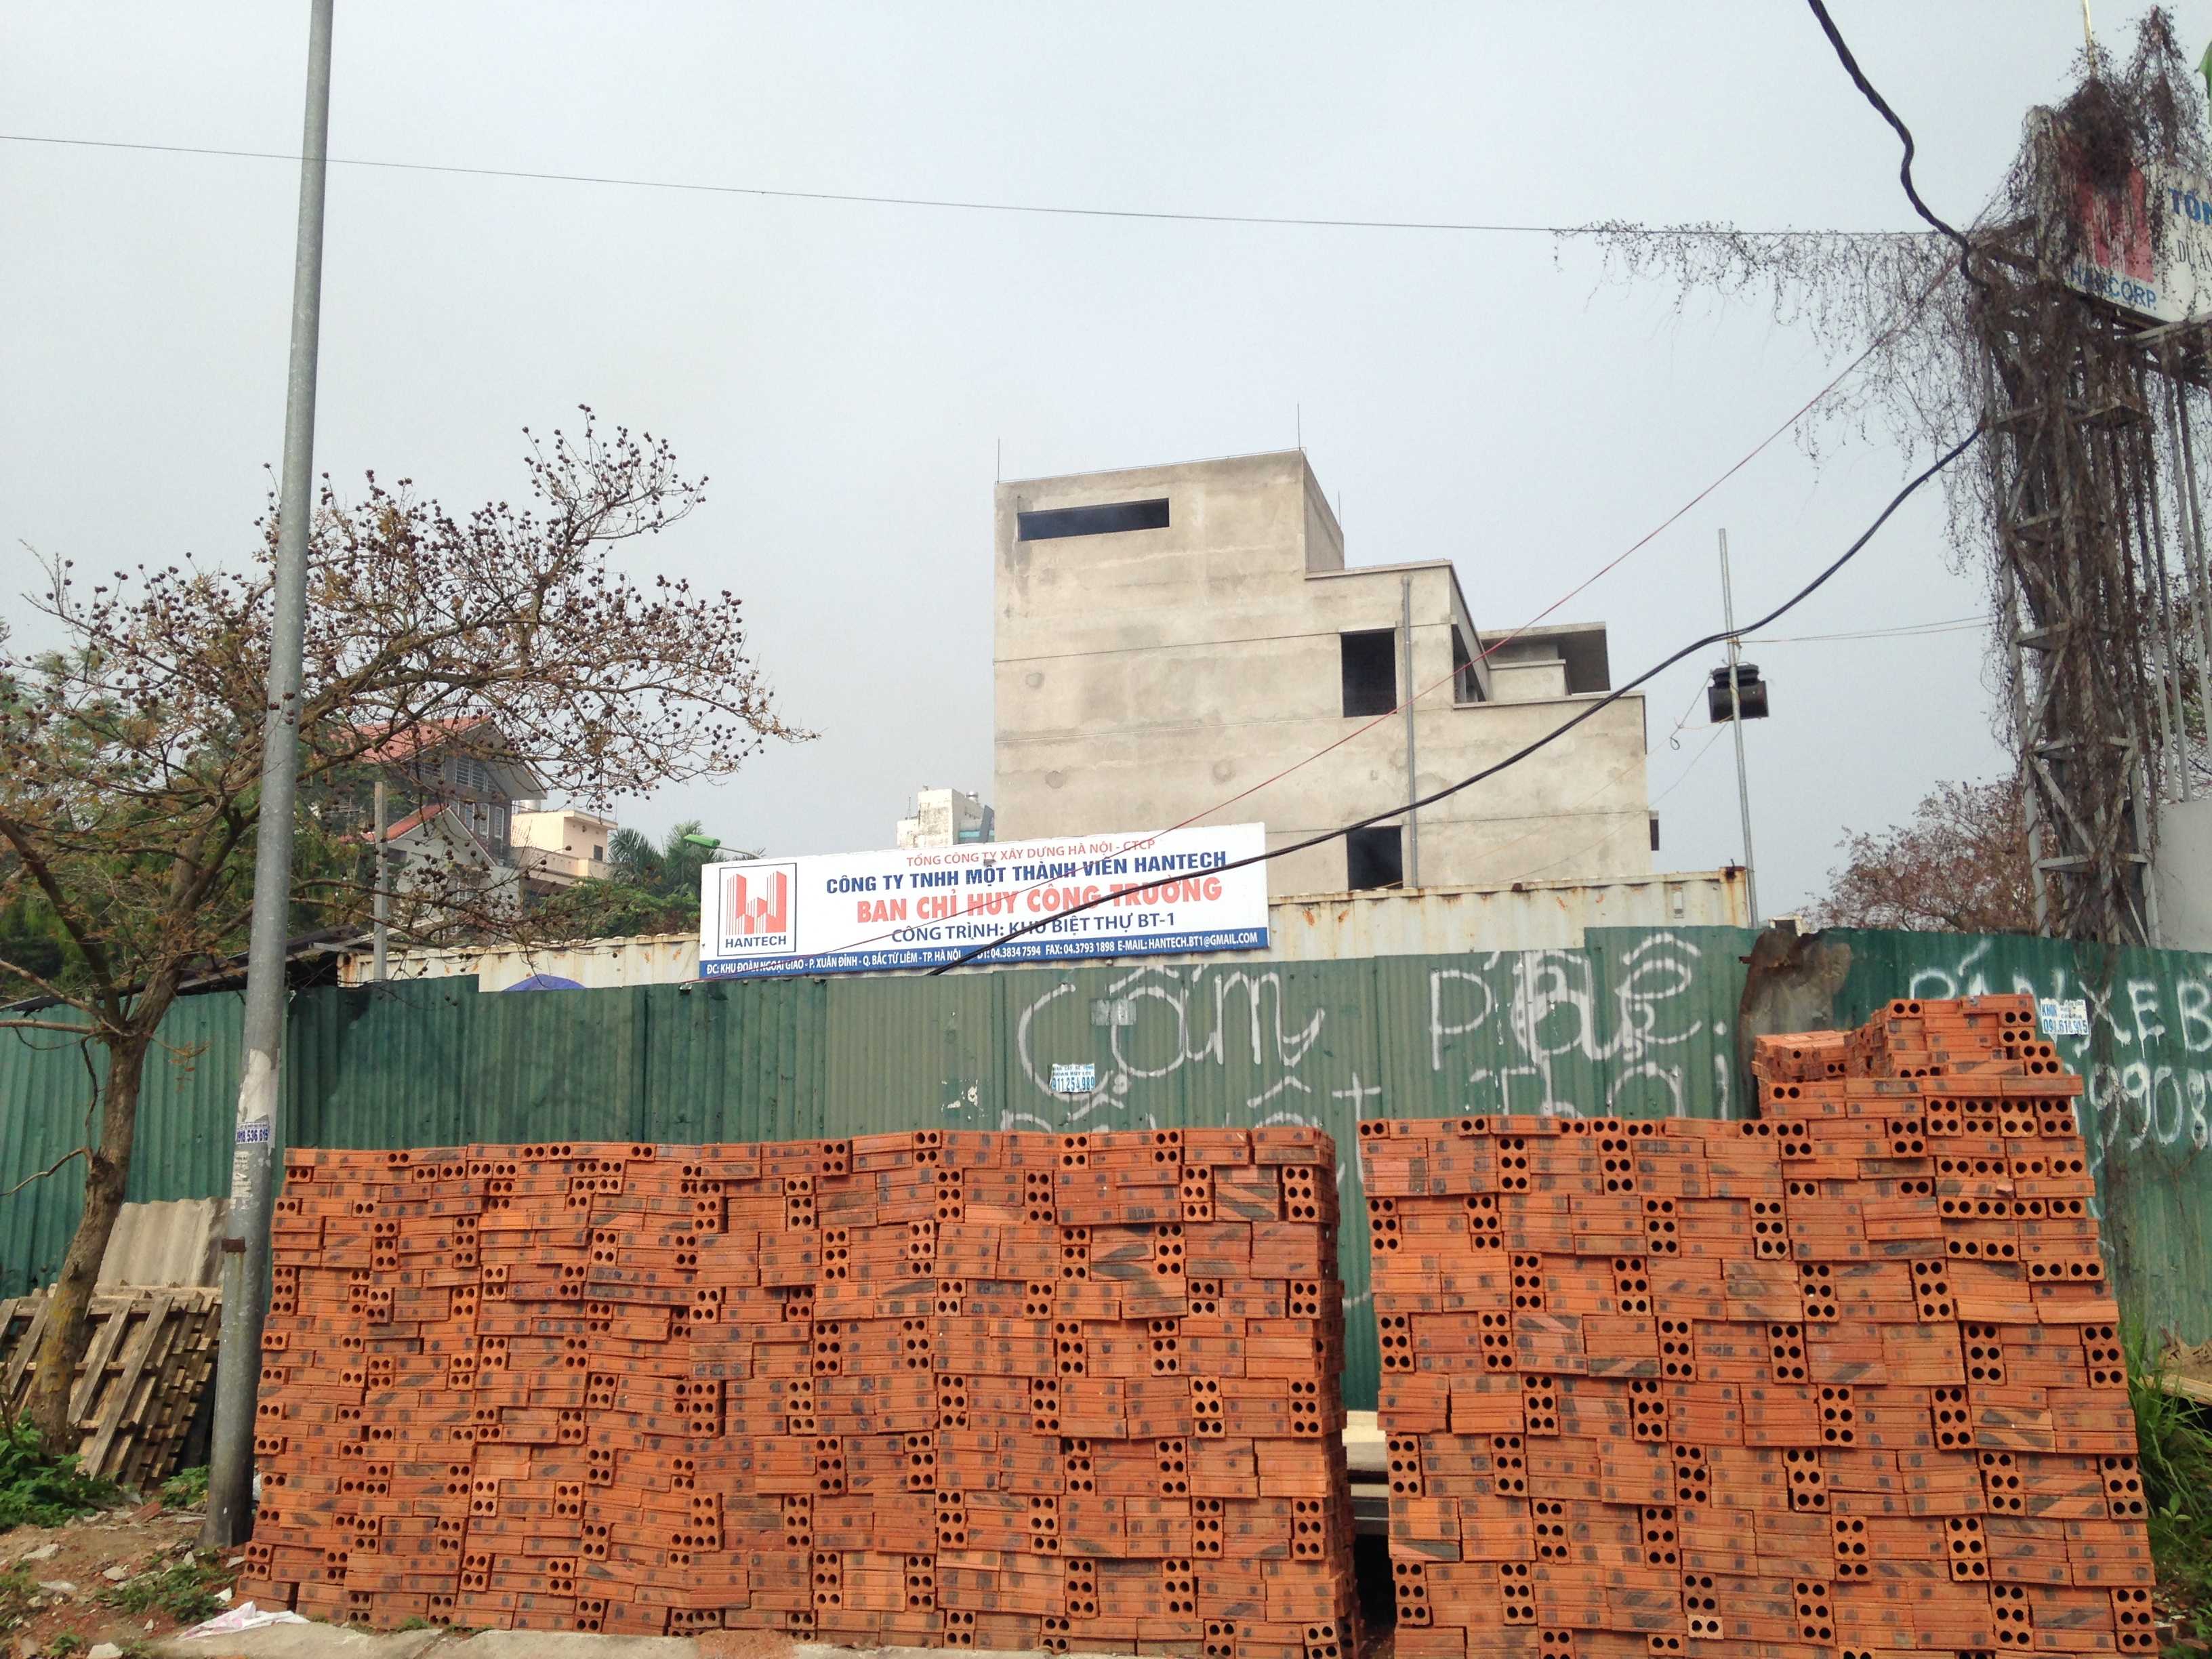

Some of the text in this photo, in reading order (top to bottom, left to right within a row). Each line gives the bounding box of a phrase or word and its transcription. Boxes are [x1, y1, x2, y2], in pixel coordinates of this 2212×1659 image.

[906, 852, 941, 867] TỔNG
[944, 851, 979, 864] CÔNG
[981, 851, 998, 861] TY
[1000, 847, 1023, 861] XÂY
[1068, 842, 1086, 855] HÀ
[1090, 841, 1113, 856] NỘI
[1123, 839, 1155, 851] CTCP
[826, 851, 1227, 894] CÔNG TY TNHH MỘT THÀNH VIÊN HANTECH
[857, 874, 1223, 923] BAN CHỈ HUY CÔNG TRƯỜNG
[725, 935, 787, 949] HANTECH
[892, 925, 941, 943] CÔNG
[945, 922, 1004, 940] TRÌNH:
[1052, 915, 1090, 936] BIỆT
[1094, 912, 1134, 933] THỰ
[1138, 912, 1175, 928] BT-1
[720, 962, 736, 974] KHU
[785, 958, 804, 970] GIAO
[816, 956, 837, 968] XUÂN
[838, 953, 857, 967] ĐỈNH
[863, 956, 871, 966] Q.
[901, 951, 918, 964] LIÊM
[935, 948, 946, 961] HÀ
[991, 946, 1021, 958] 04.3834
[1022, 945, 1041, 956] 7594
[1045, 944, 1063, 956] FAX:
[1064, 943, 1094, 954] 04.3793
[1096, 941, 1115, 952] 1898
[1118, 940, 1147, 951] E-MAIL:
[1148, 932, 1258, 949] HANTECH.BT1@GMAIL.COM
